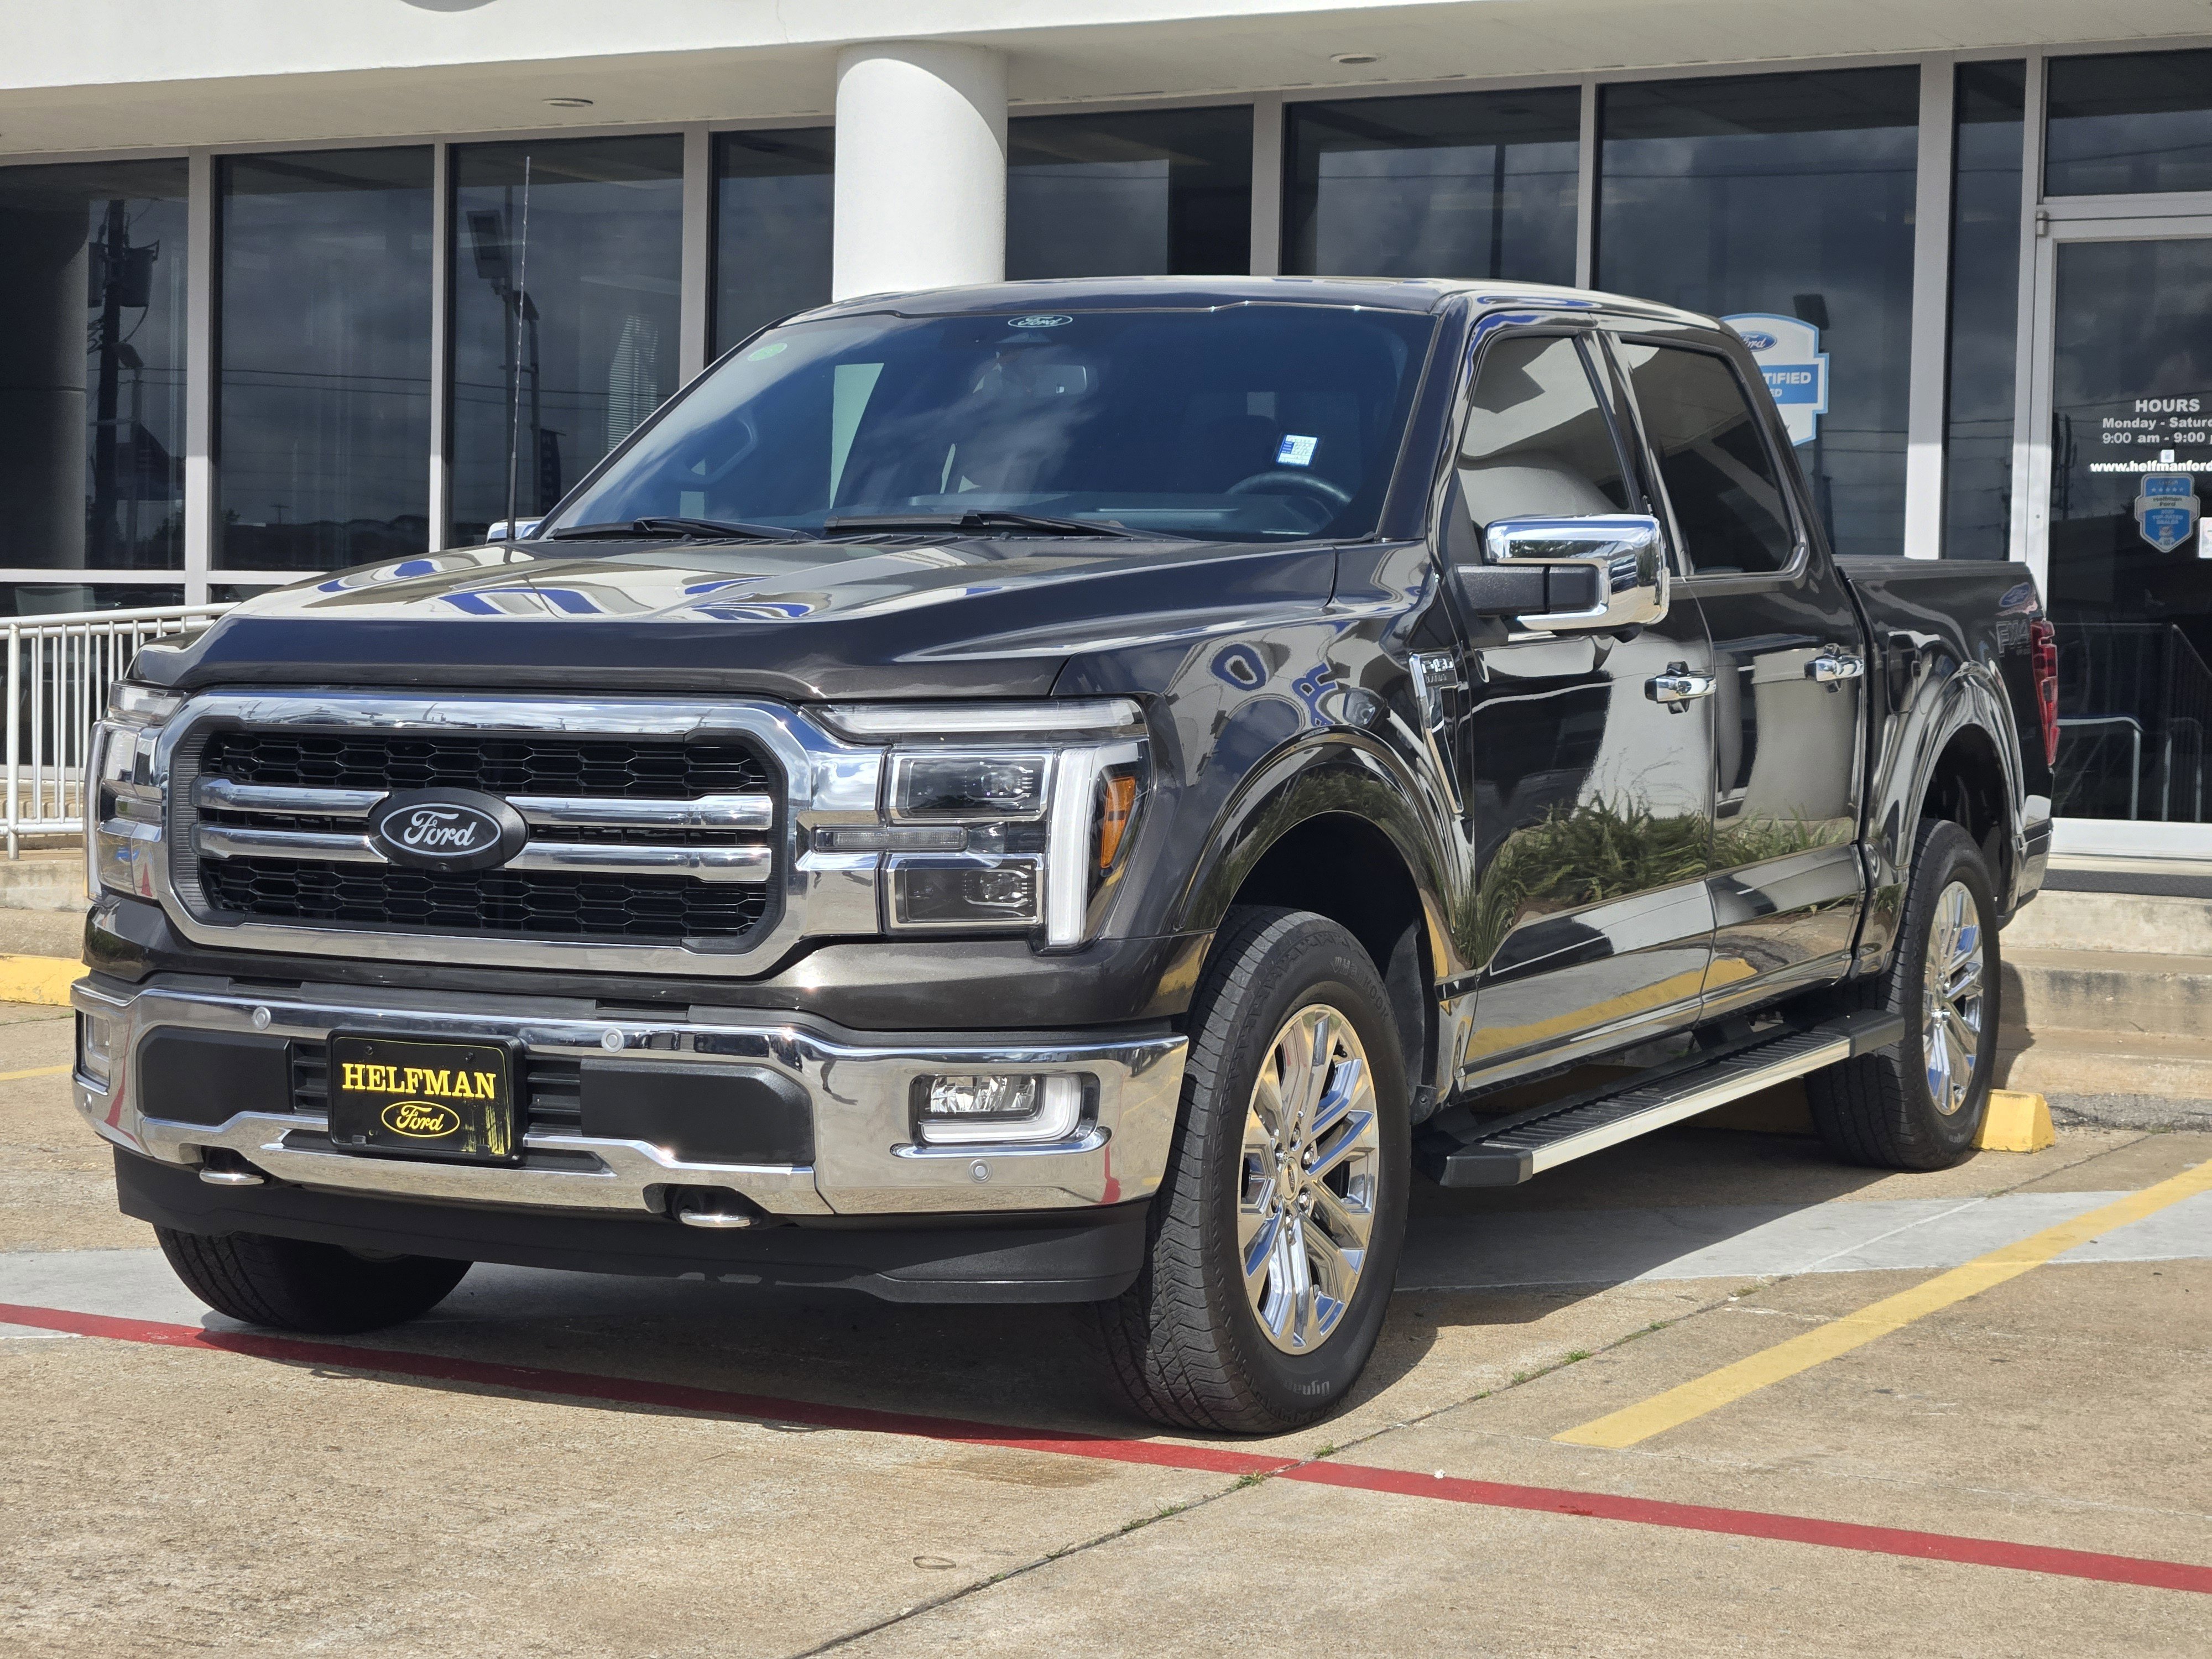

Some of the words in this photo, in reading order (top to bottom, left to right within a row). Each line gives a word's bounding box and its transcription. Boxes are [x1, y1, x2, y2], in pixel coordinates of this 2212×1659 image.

[1018, 316, 1063, 326] Ford
[1764, 372, 1812, 384] TIFIED
[2135, 399, 2200, 413] HOURS
[2103, 418, 2157, 430] Monday
[2103, 432, 2132, 444] 9:00
[2137, 435, 2160, 443] am
[2174, 432, 2205, 443] 9:00
[404, 811, 477, 847] Ford
[342, 1063, 496, 1099] HELFMAN
[396, 1105, 445, 1131] Ford
